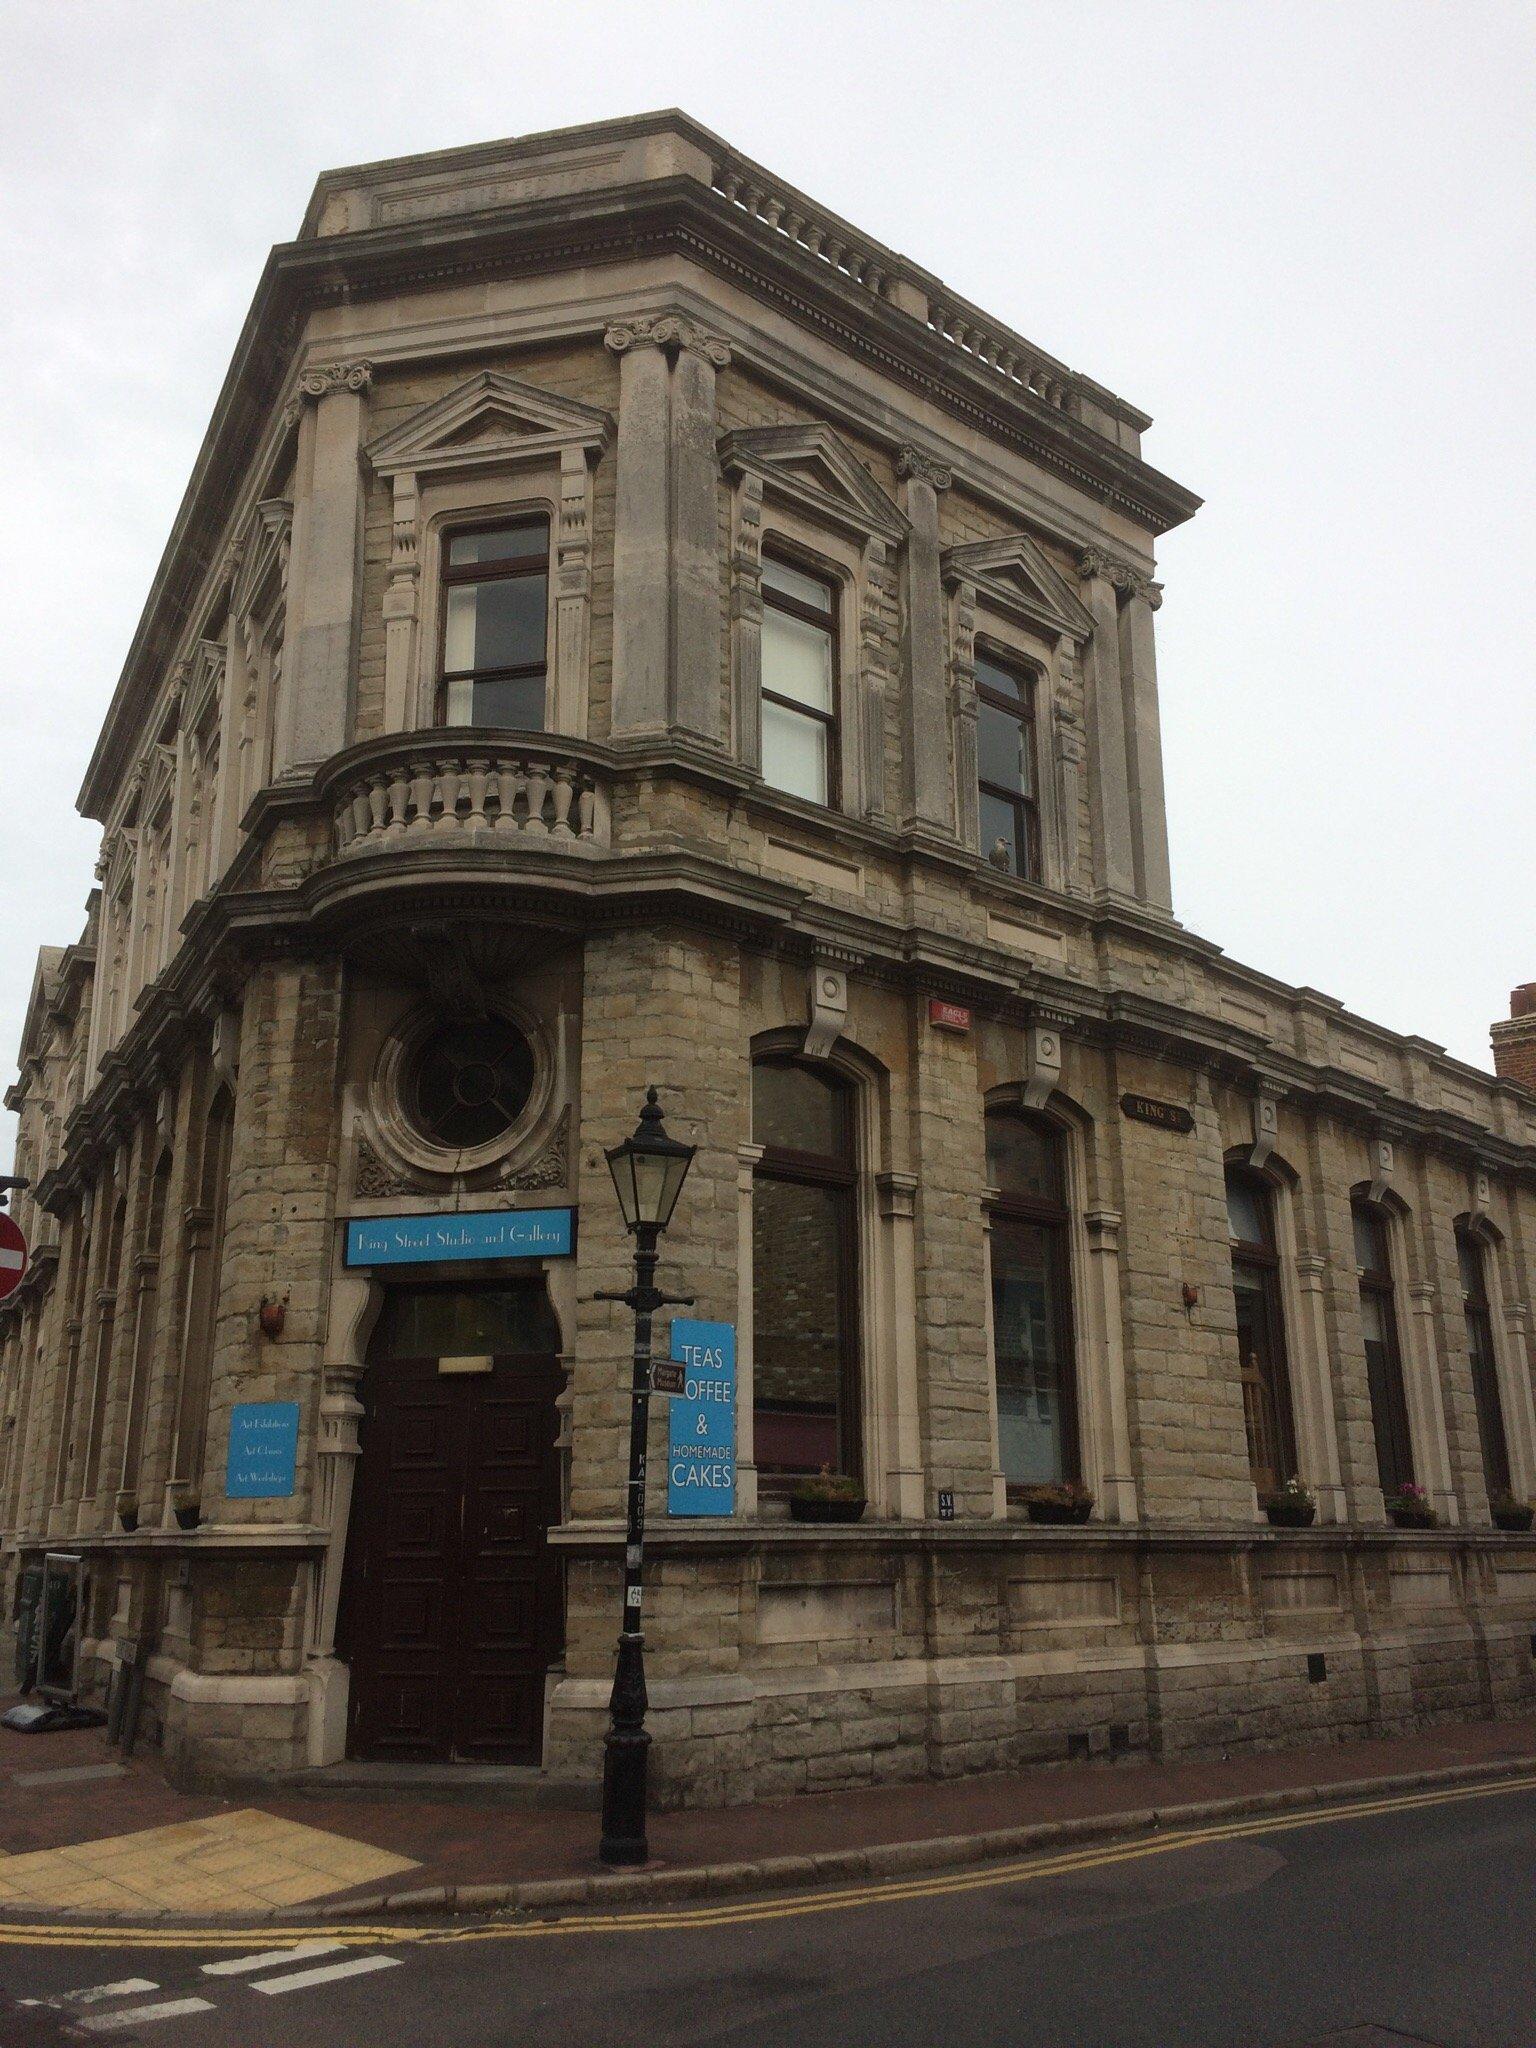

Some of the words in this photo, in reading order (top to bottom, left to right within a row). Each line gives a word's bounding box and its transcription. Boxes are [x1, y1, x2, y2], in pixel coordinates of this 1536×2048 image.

[1136, 1101, 1164, 1119] KING
[358, 1233, 388, 1252] King
[395, 1231, 429, 1248] Street
[436, 1229, 475, 1246] Studio
[482, 1226, 504, 1244] and
[510, 1224, 561, 1245] Gallery
[681, 1345, 723, 1369] TEAS
[685, 1379, 731, 1403] OFFEE
[696, 1413, 708, 1435] &
[673, 1445, 731, 1460] HOMEMADE
[672, 1463, 731, 1488] CAKES
